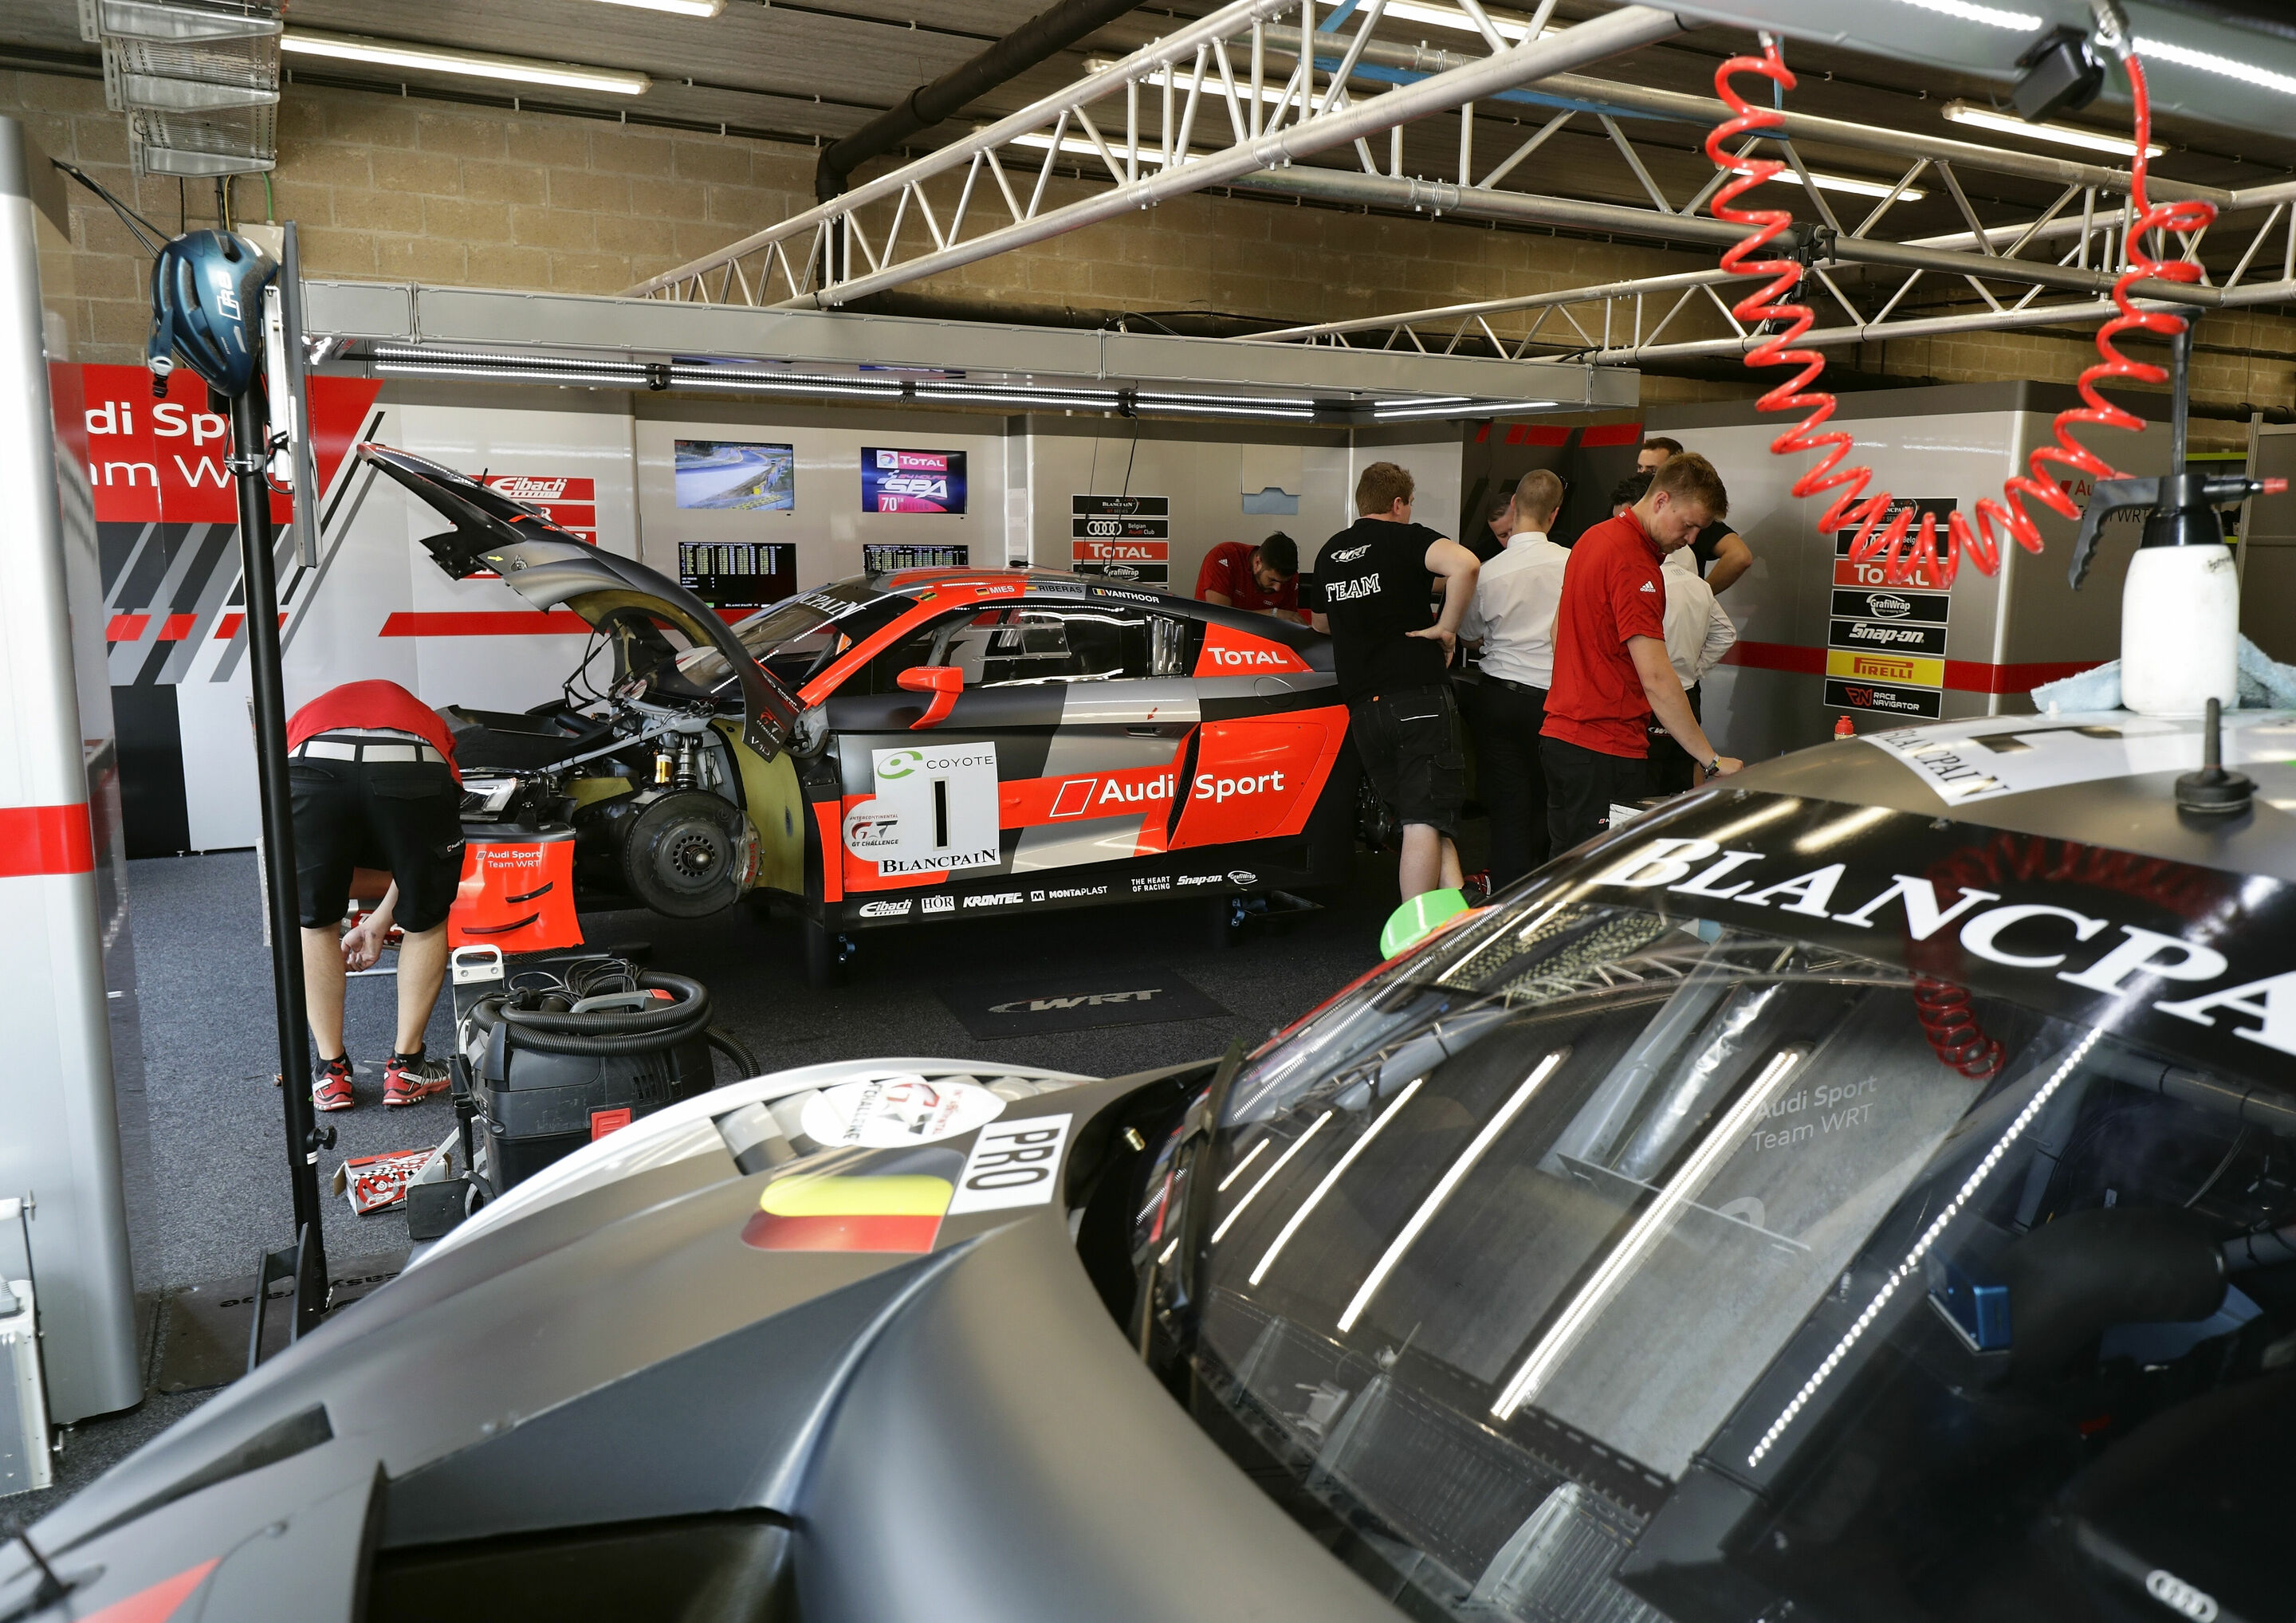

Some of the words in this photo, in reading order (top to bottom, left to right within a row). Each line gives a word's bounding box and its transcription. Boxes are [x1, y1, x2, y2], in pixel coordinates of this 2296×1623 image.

[900, 456, 944, 467] TOTAL
[490, 477, 567, 498] Eibach
[883, 479, 948, 498] SPA
[2117, 508, 2150, 523] WRT
[1089, 544, 1152, 558] TOTAL
[1854, 564, 1929, 586] TOAL
[1106, 590, 1159, 603] VANTHOOR
[1325, 573, 1382, 602] TEAM
[1870, 599, 1910, 611] GrafiWrap
[1849, 623, 1924, 643] Snap-on
[1207, 647, 1288, 666] TOTAL
[1854, 657, 1913, 678] PIRELLI
[1873, 691, 1896, 701] RACE
[1873, 699, 1920, 710] NAVIGATOR
[926, 756, 993, 769] COYOTE
[1099, 774, 1174, 804] Audi
[1195, 770, 1285, 804] Sport
[512, 851, 541, 860] Sport
[882, 848, 997, 873] BLANCPAIN
[1177, 875, 1222, 885] Snap-on
[963, 892, 1024, 908] KRONTEC
[1049, 886, 1107, 899] MONTAPLAST
[859, 899, 913, 917] Eibach
[923, 895, 953, 909] HÖR
[1587, 838, 2296, 1058] BLANCPA
[1755, 1091, 1807, 1120] Audi
[1814, 1075, 1877, 1108] Sport
[1751, 1124, 1814, 1151] Team
[1822, 1103, 1873, 1134] WRT
[966, 1127, 1061, 1190] PRO
